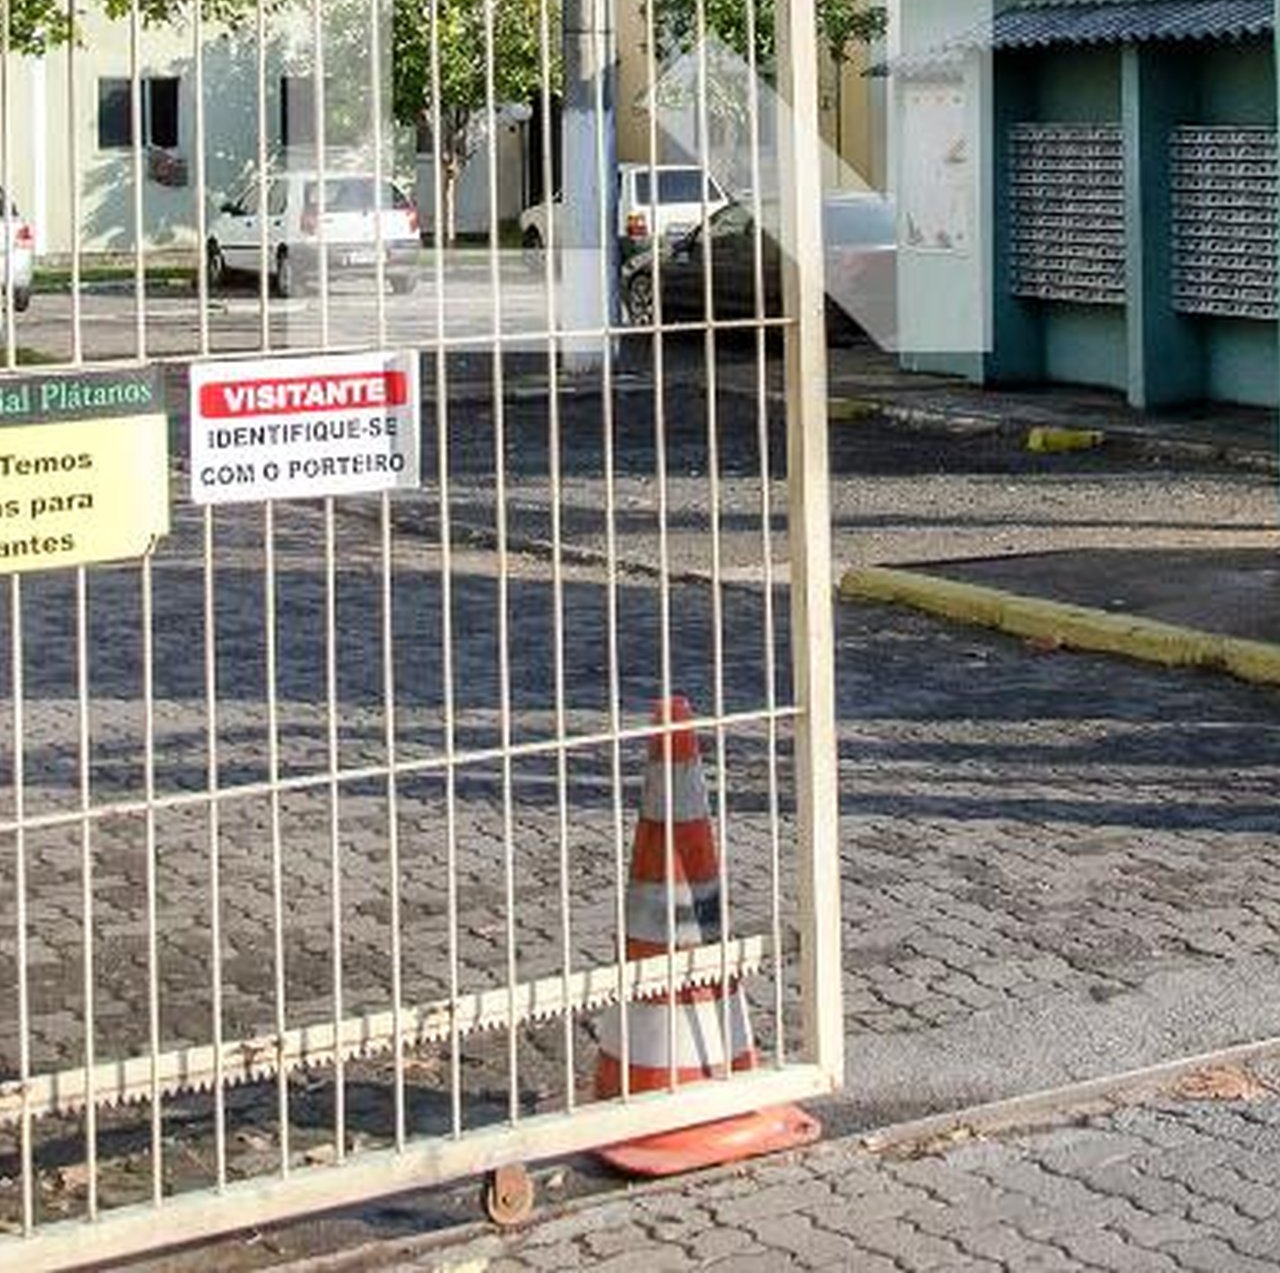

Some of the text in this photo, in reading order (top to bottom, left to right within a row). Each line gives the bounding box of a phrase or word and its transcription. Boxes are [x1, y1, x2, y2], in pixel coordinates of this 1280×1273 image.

[40, 381, 153, 411] Plátanos
[223, 377, 388, 413] VISITANTE
[206, 415, 399, 450] IDENTIFIQUE-SE
[199, 453, 405, 486] COM O PORTEIRO
[30, 492, 94, 521] para
